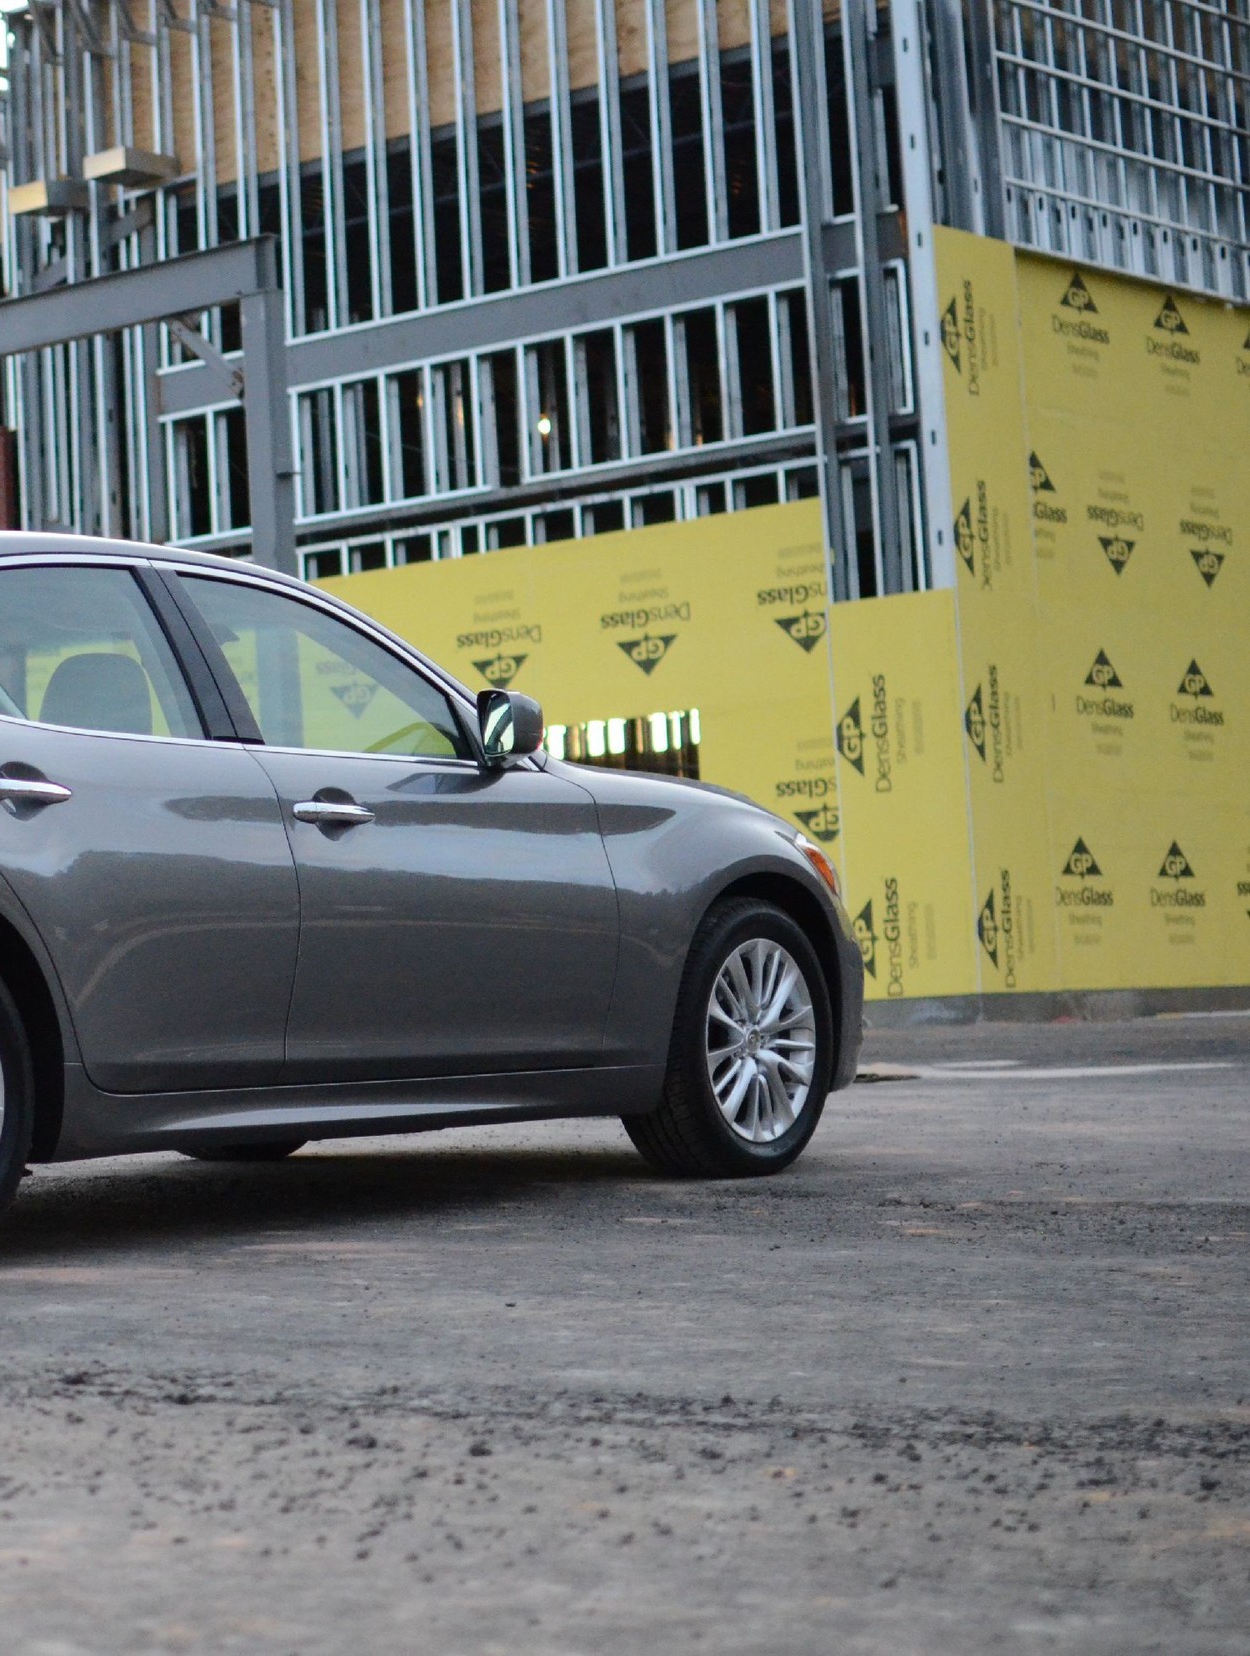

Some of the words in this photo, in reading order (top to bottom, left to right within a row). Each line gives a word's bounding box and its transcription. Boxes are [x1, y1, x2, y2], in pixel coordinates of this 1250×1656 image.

[600, 602, 691, 628] DensGlass
[456, 624, 542, 648] DensGlass
[1075, 695, 1134, 719] DensGlass
[1170, 703, 1225, 726] DensGlass
[872, 674, 892, 793] DensGlass
[1151, 888, 1206, 907] DensGlass
[884, 877, 904, 996] DensGlass
